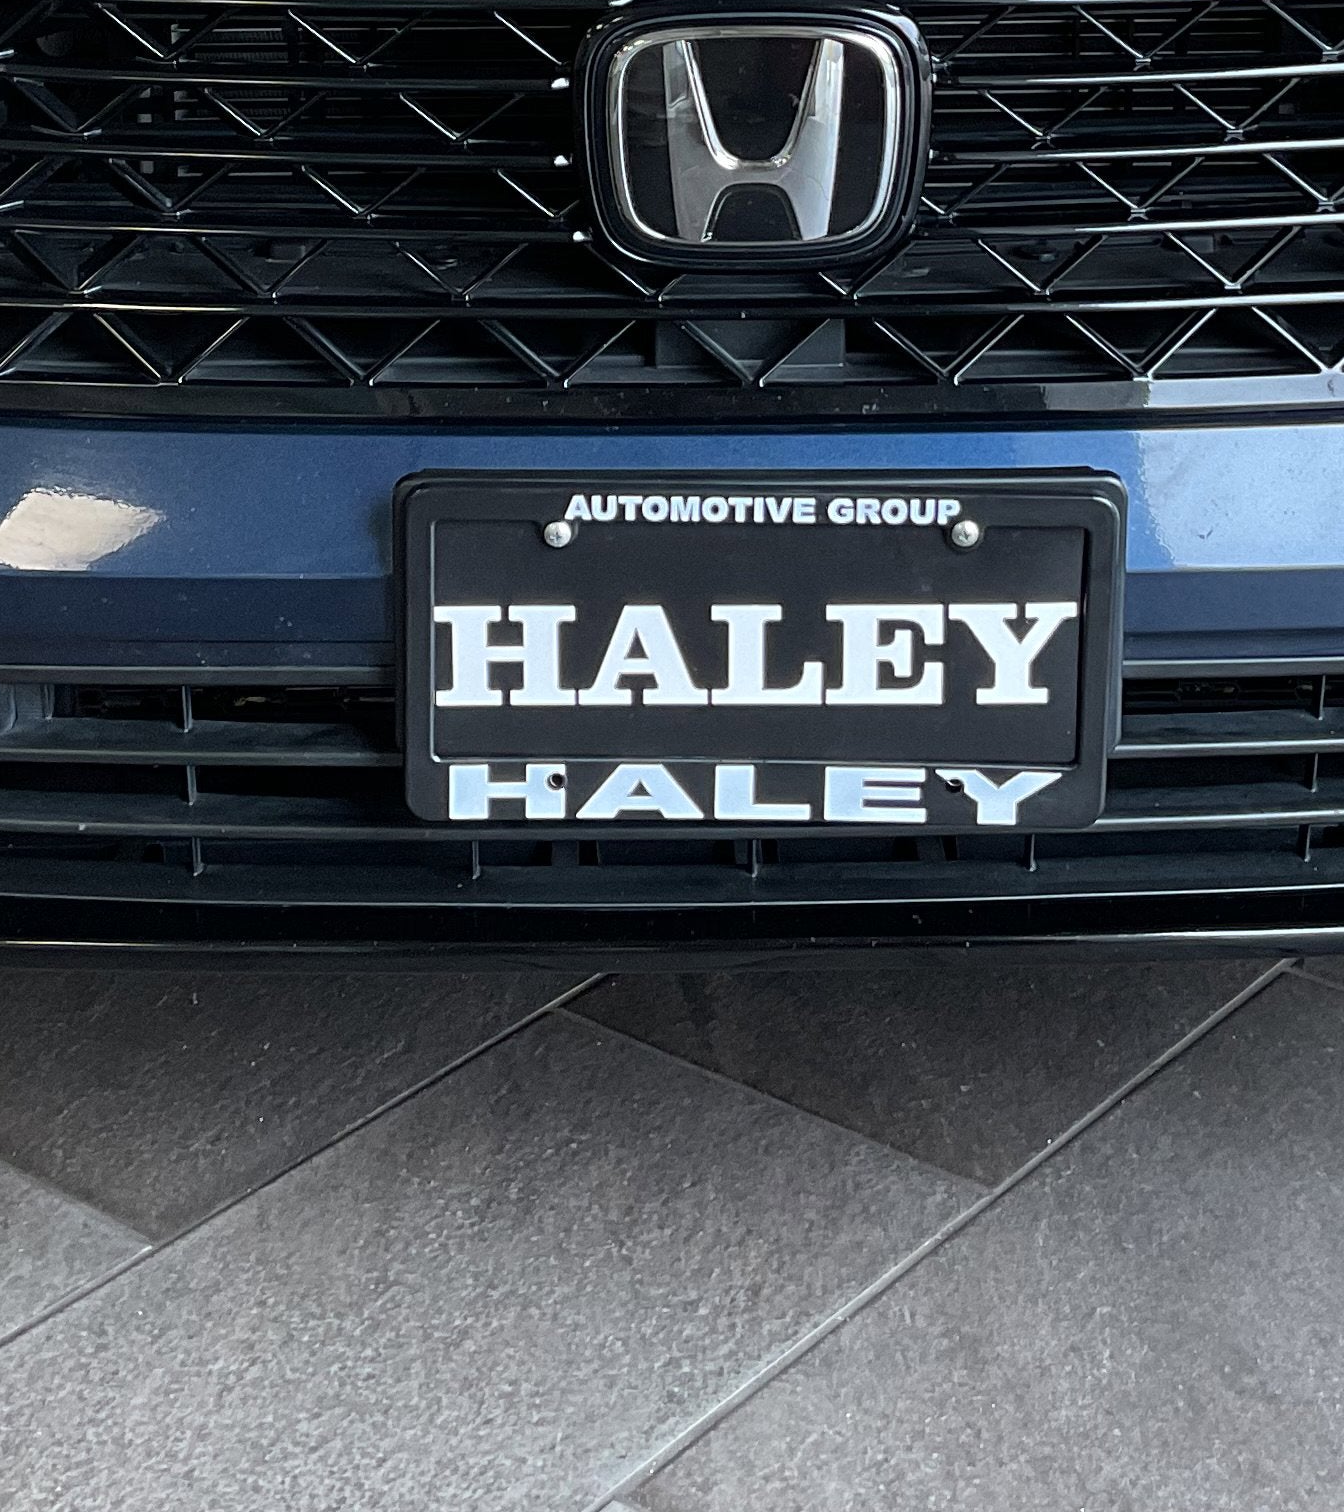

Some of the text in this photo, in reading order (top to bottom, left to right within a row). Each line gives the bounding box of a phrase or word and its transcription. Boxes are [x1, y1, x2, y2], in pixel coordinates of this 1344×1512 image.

[564, 494, 961, 526] AUTOMOTIVE GROUP
[432, 601, 1078, 707] HALEY
[448, 762, 1063, 826] HALEY
